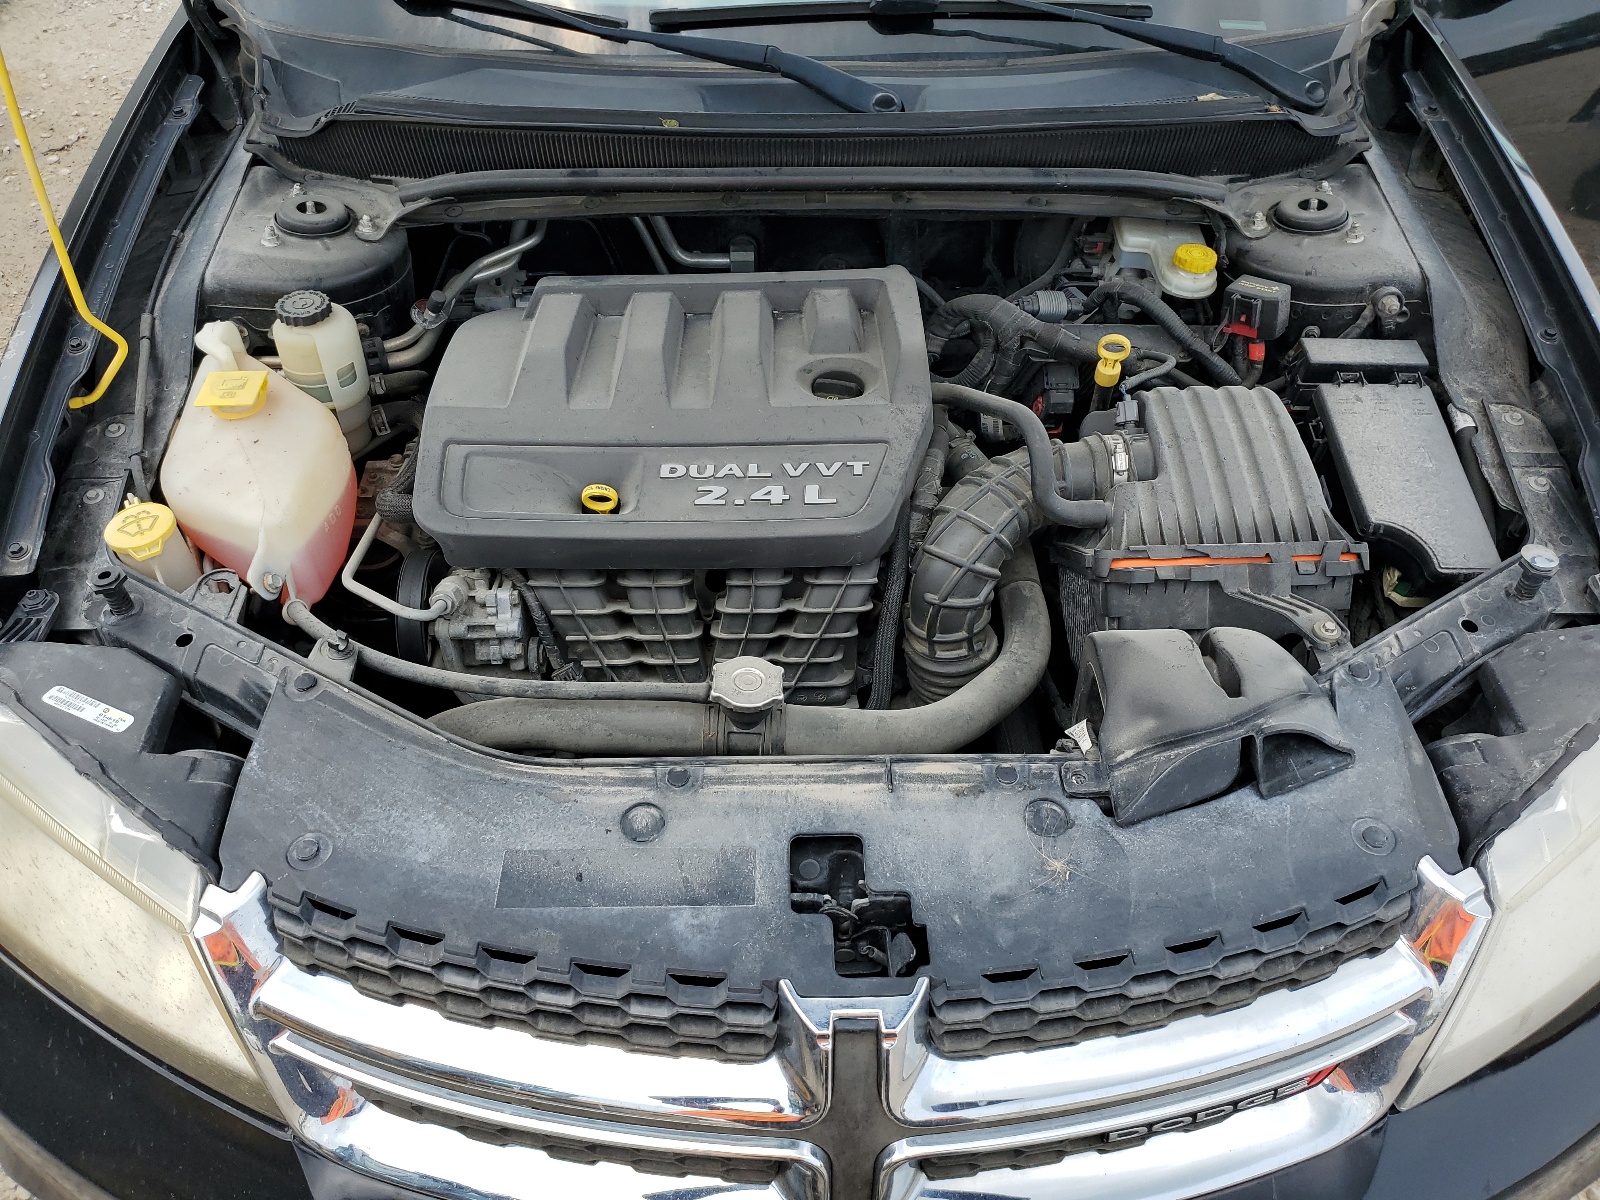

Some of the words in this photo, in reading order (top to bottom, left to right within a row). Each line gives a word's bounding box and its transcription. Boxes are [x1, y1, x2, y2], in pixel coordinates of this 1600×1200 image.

[660, 463, 772, 479] DUAL
[781, 461, 870, 478] VVT
[1107, 1077, 1309, 1142] DODGE
